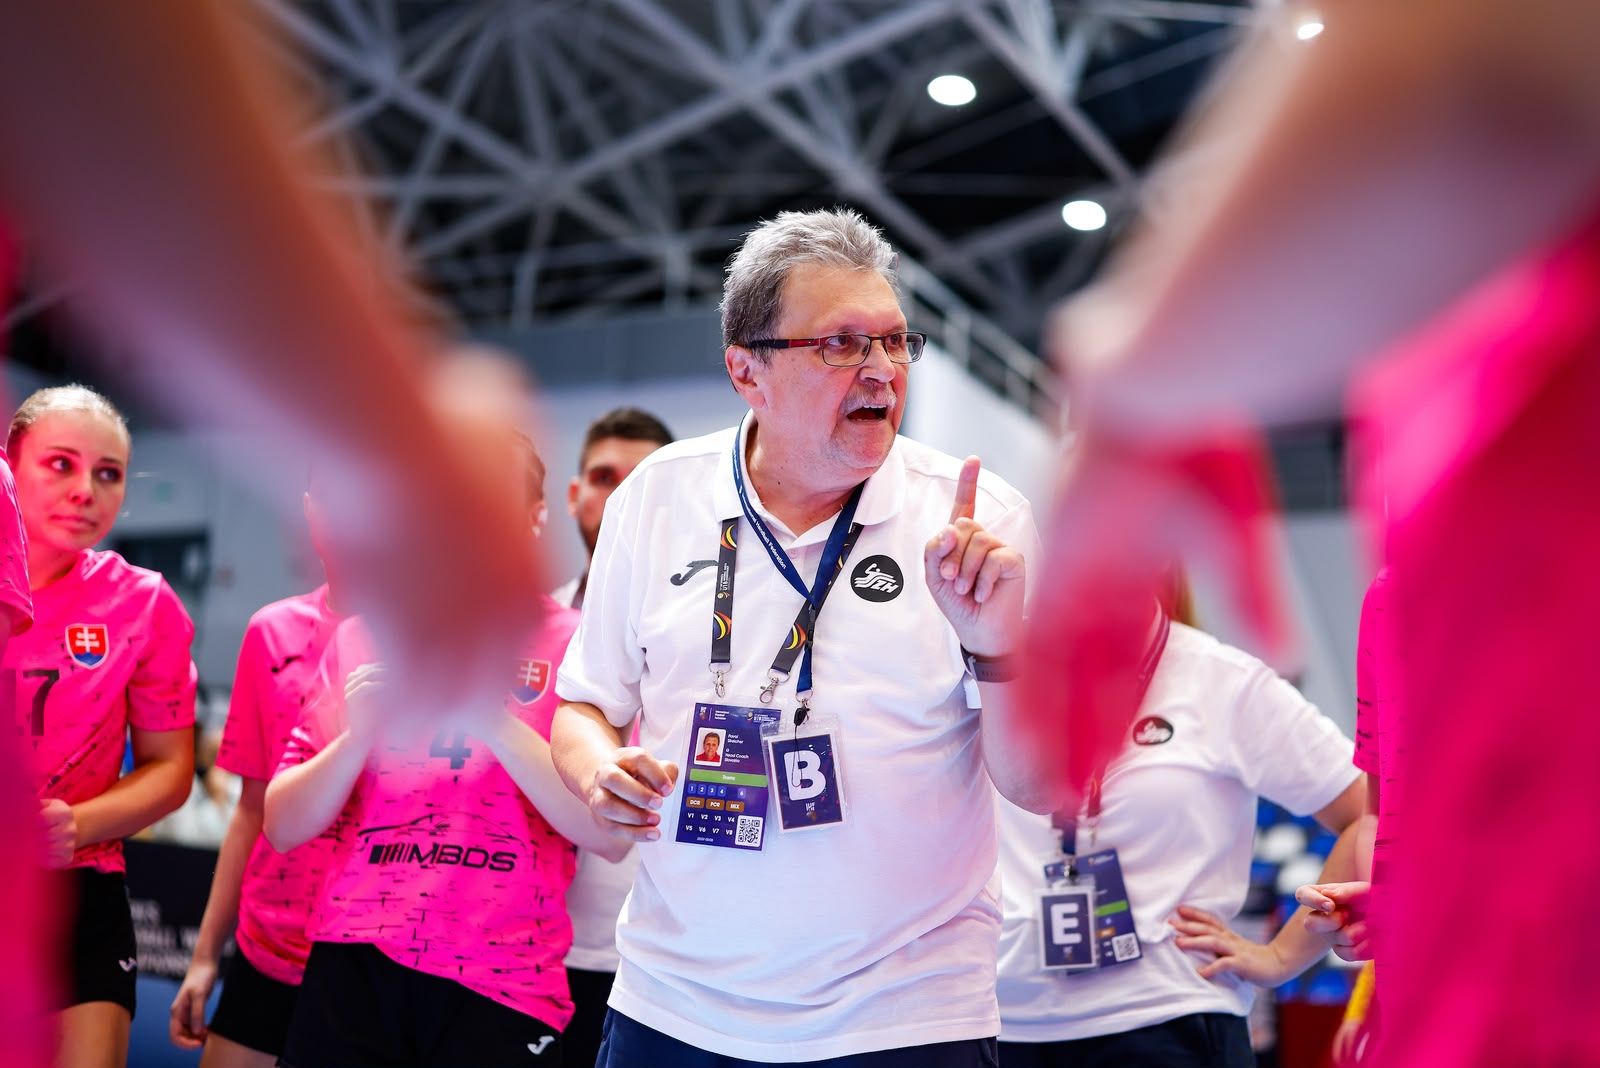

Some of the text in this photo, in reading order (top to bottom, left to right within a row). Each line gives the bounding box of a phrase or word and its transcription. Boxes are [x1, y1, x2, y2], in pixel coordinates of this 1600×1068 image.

[768, 541, 787, 570] Federation
[783, 750, 827, 801] B
[406, 842, 517, 872] MBDS
[1050, 902, 1082, 945] E
